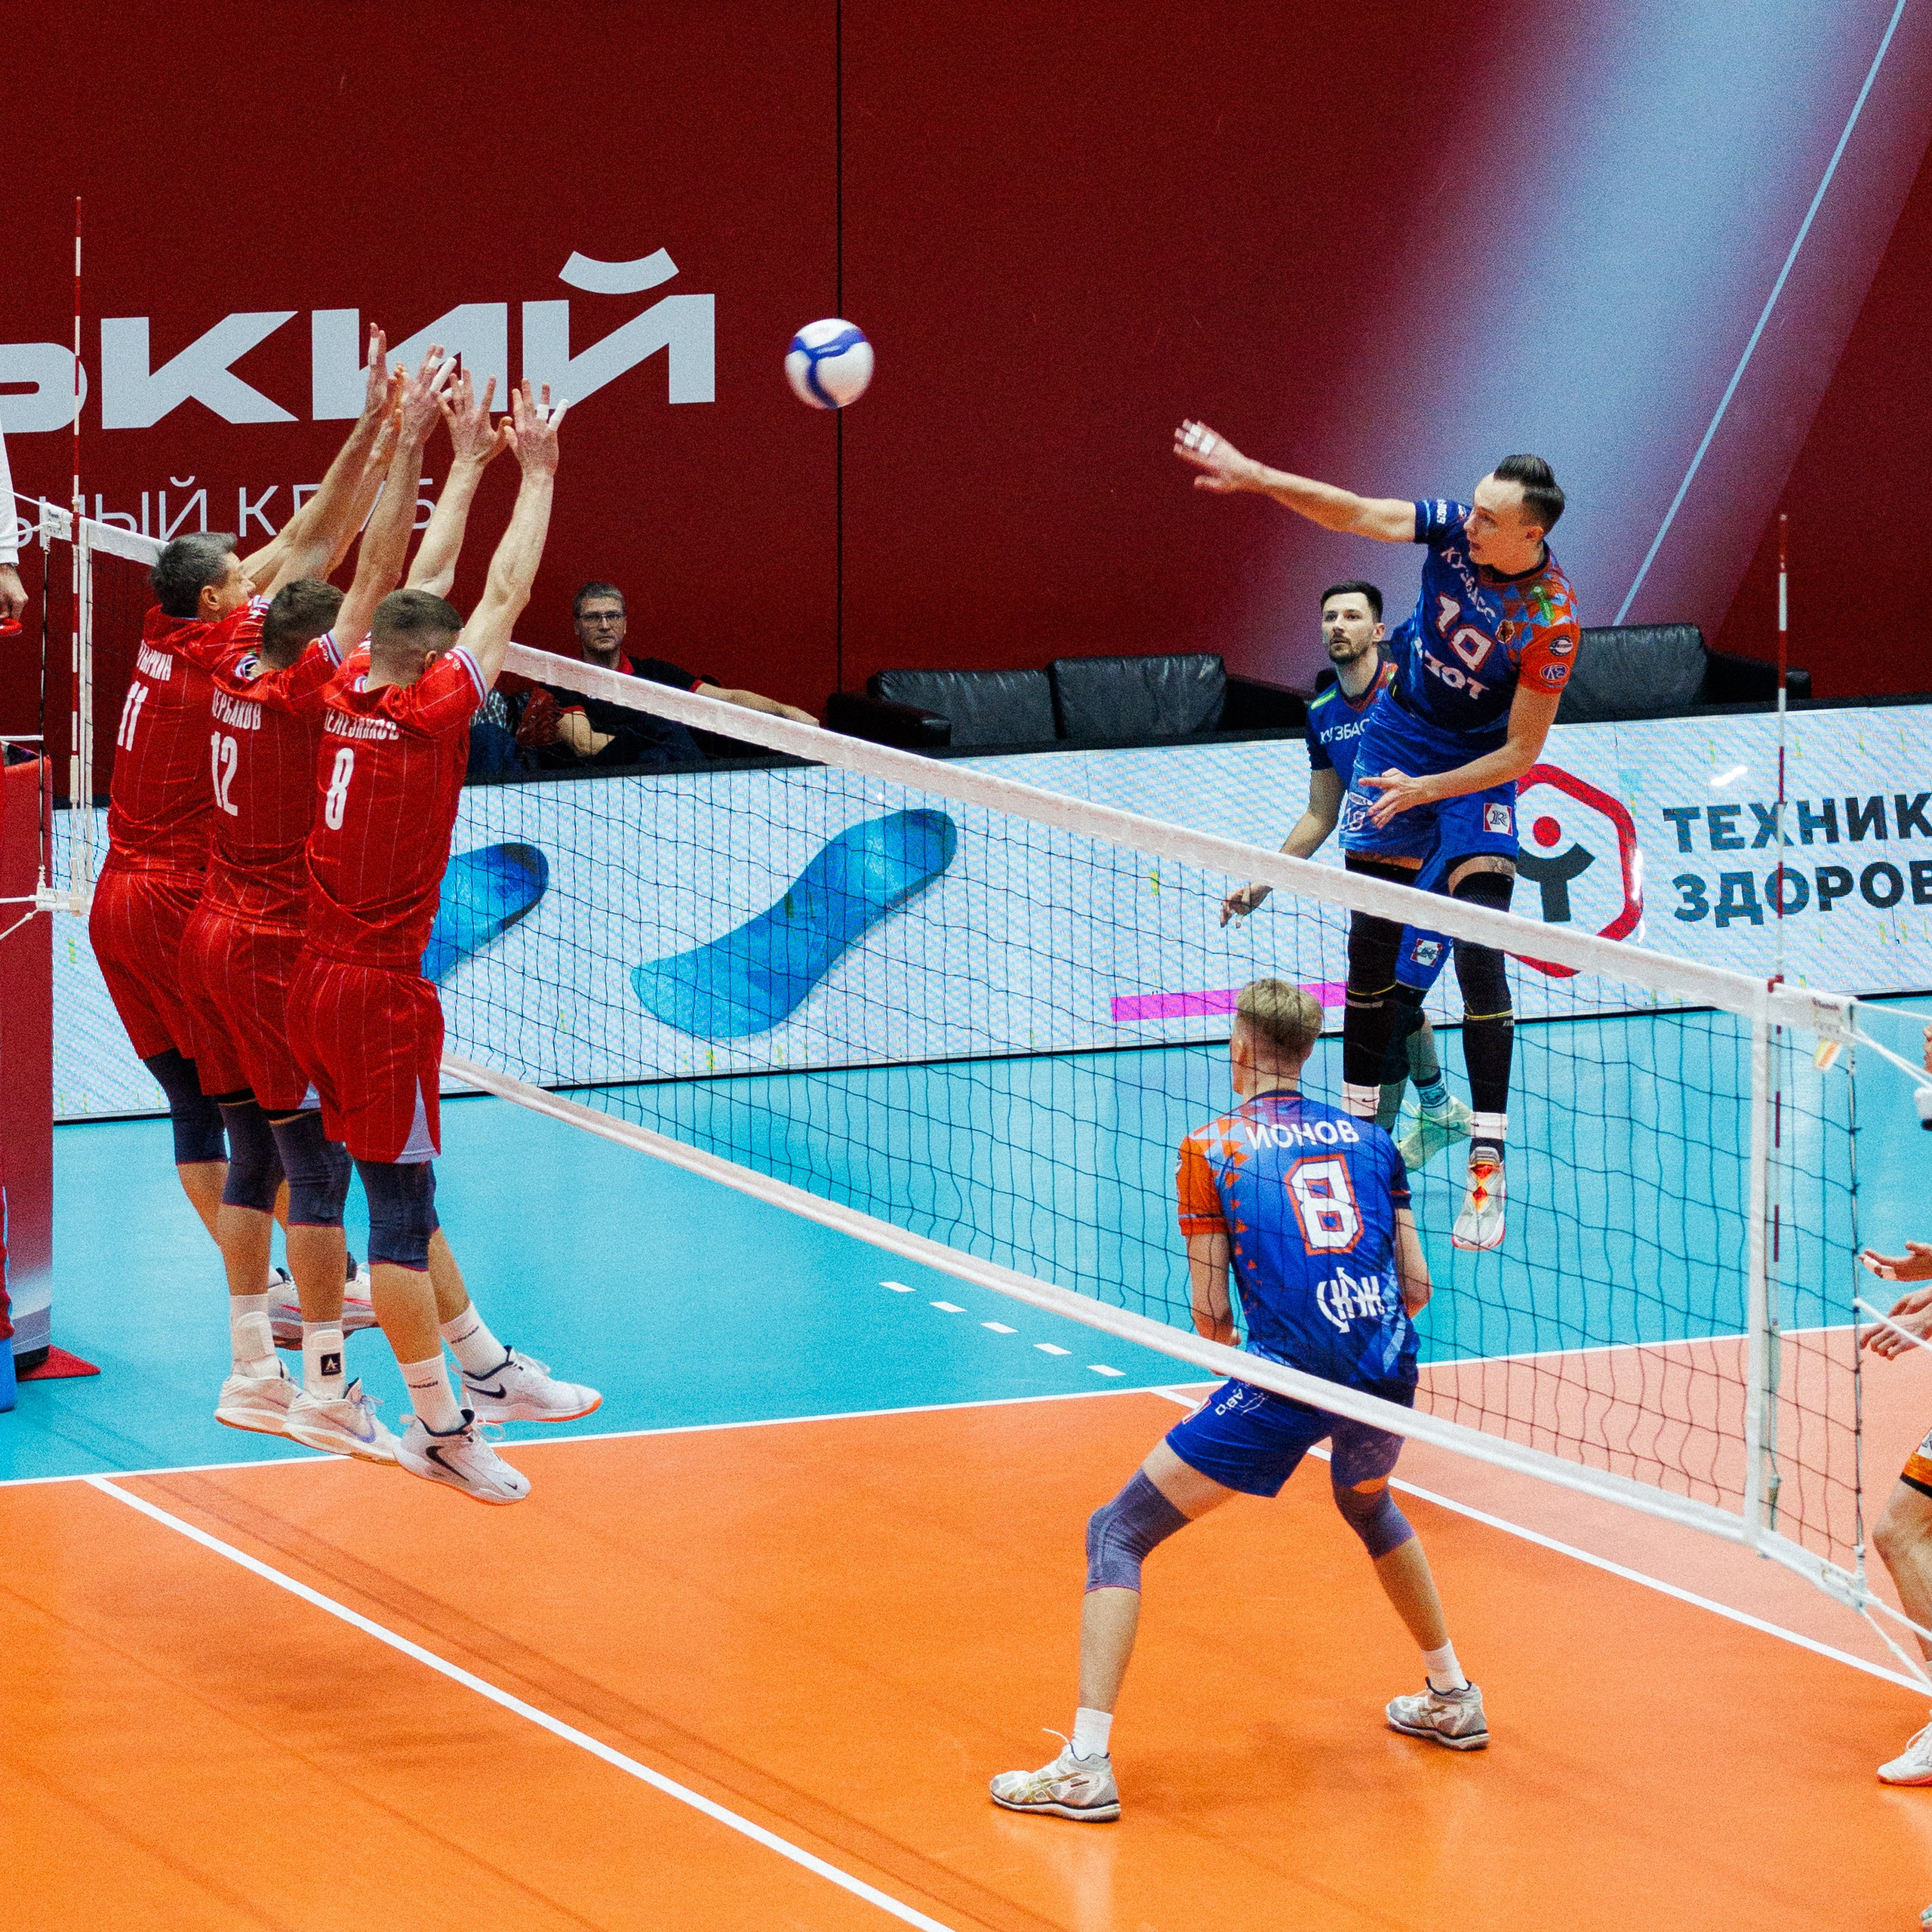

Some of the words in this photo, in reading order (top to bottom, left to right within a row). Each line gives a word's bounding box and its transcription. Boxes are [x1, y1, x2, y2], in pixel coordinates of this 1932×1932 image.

[117, 680, 149, 752] 11
[211, 731, 238, 817] 12
[325, 747, 355, 831] 8
[1663, 792, 1932, 854] ТЕХНИК
[1245, 1119, 1360, 1150] ИОНОВ
[1287, 1156, 1362, 1254] 8
